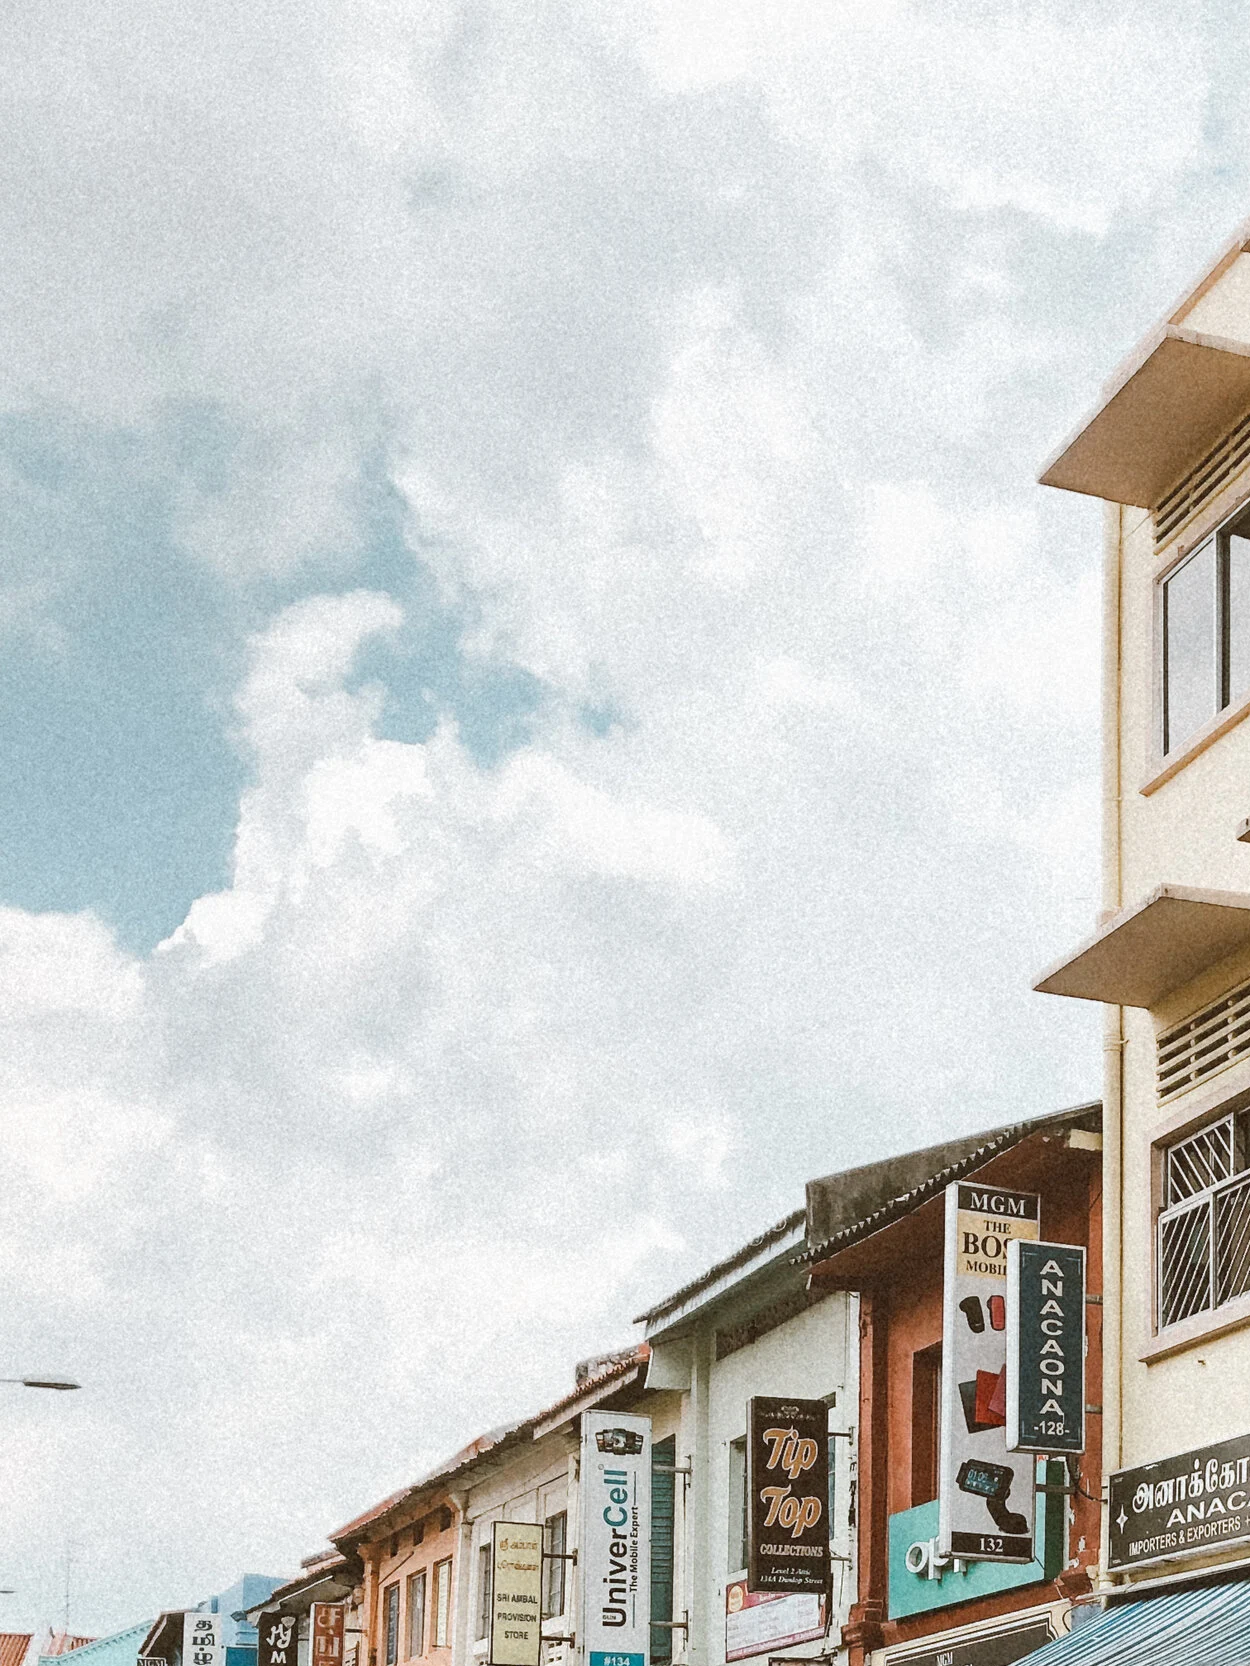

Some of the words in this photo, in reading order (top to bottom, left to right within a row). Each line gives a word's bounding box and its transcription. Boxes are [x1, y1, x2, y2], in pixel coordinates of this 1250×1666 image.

[969, 1191, 1026, 1216] MGM
[983, 1219, 1012, 1235] THE
[1039, 1258, 1065, 1416] ANACAONA
[762, 1425, 819, 1480] Tip
[628, 1506, 639, 1541] Expert
[759, 1483, 822, 1539] Top
[603, 1469, 628, 1628] UniverCell
[979, 1537, 1004, 1552] 132
[1128, 1530, 1178, 1557] IMPORTERS
[1178, 1530, 1186, 1545] &
[1186, 1515, 1242, 1543] EXPORTERS
[628, 1542, 639, 1574] Mobile
[759, 1543, 824, 1558] COLLECTIONS
[628, 1577, 638, 1593] The
[496, 1593, 510, 1602] SRI
[511, 1594, 538, 1605] AMBAL
[497, 1612, 537, 1623] PROVISION
[504, 1630, 529, 1640] STORE
